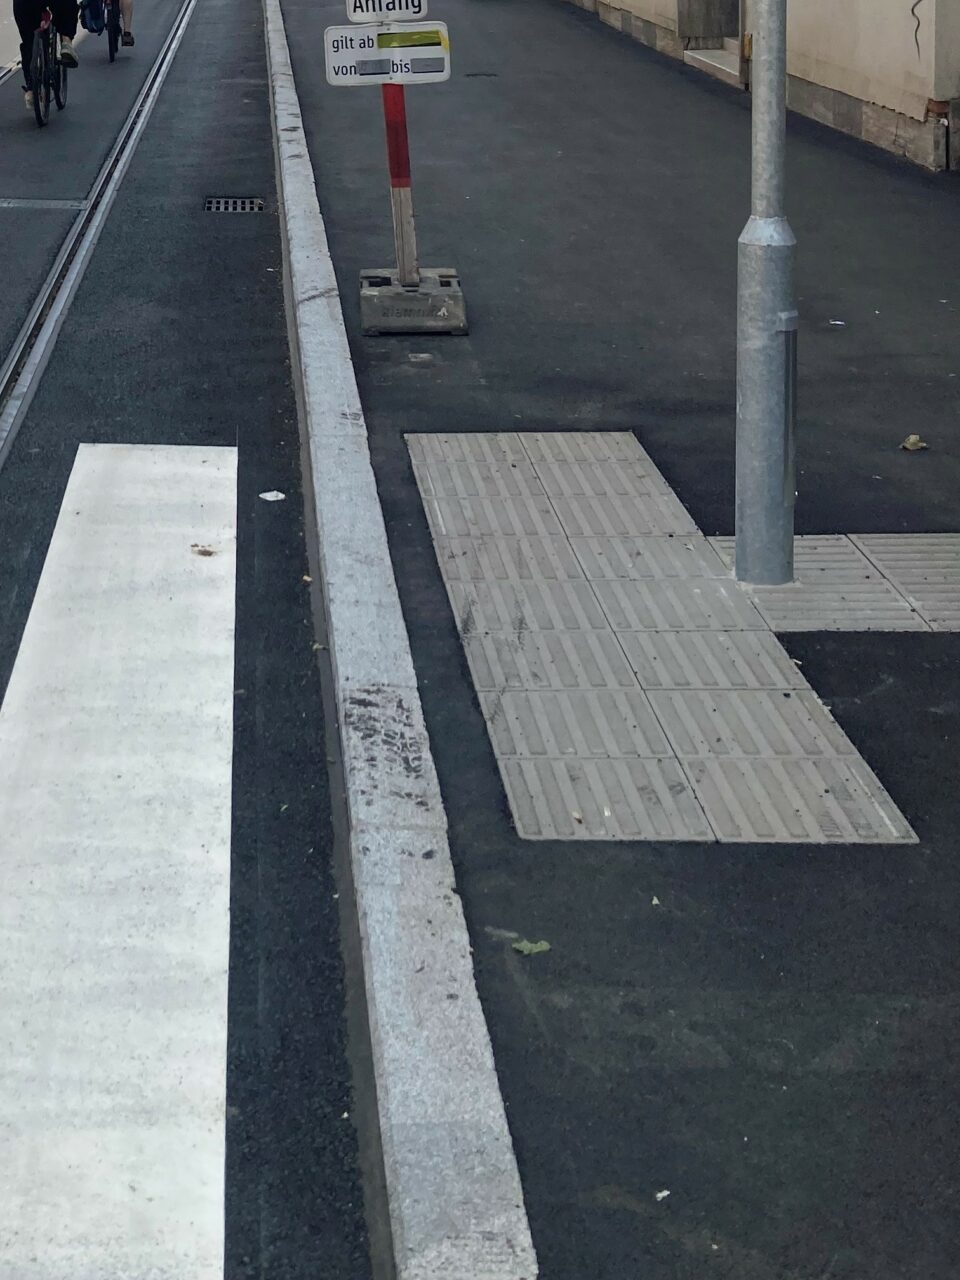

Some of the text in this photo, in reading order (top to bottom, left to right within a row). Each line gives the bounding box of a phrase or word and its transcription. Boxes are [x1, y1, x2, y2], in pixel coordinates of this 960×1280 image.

[332, 35, 374, 53] gilt ab
[333, 60, 410, 76] von bis
